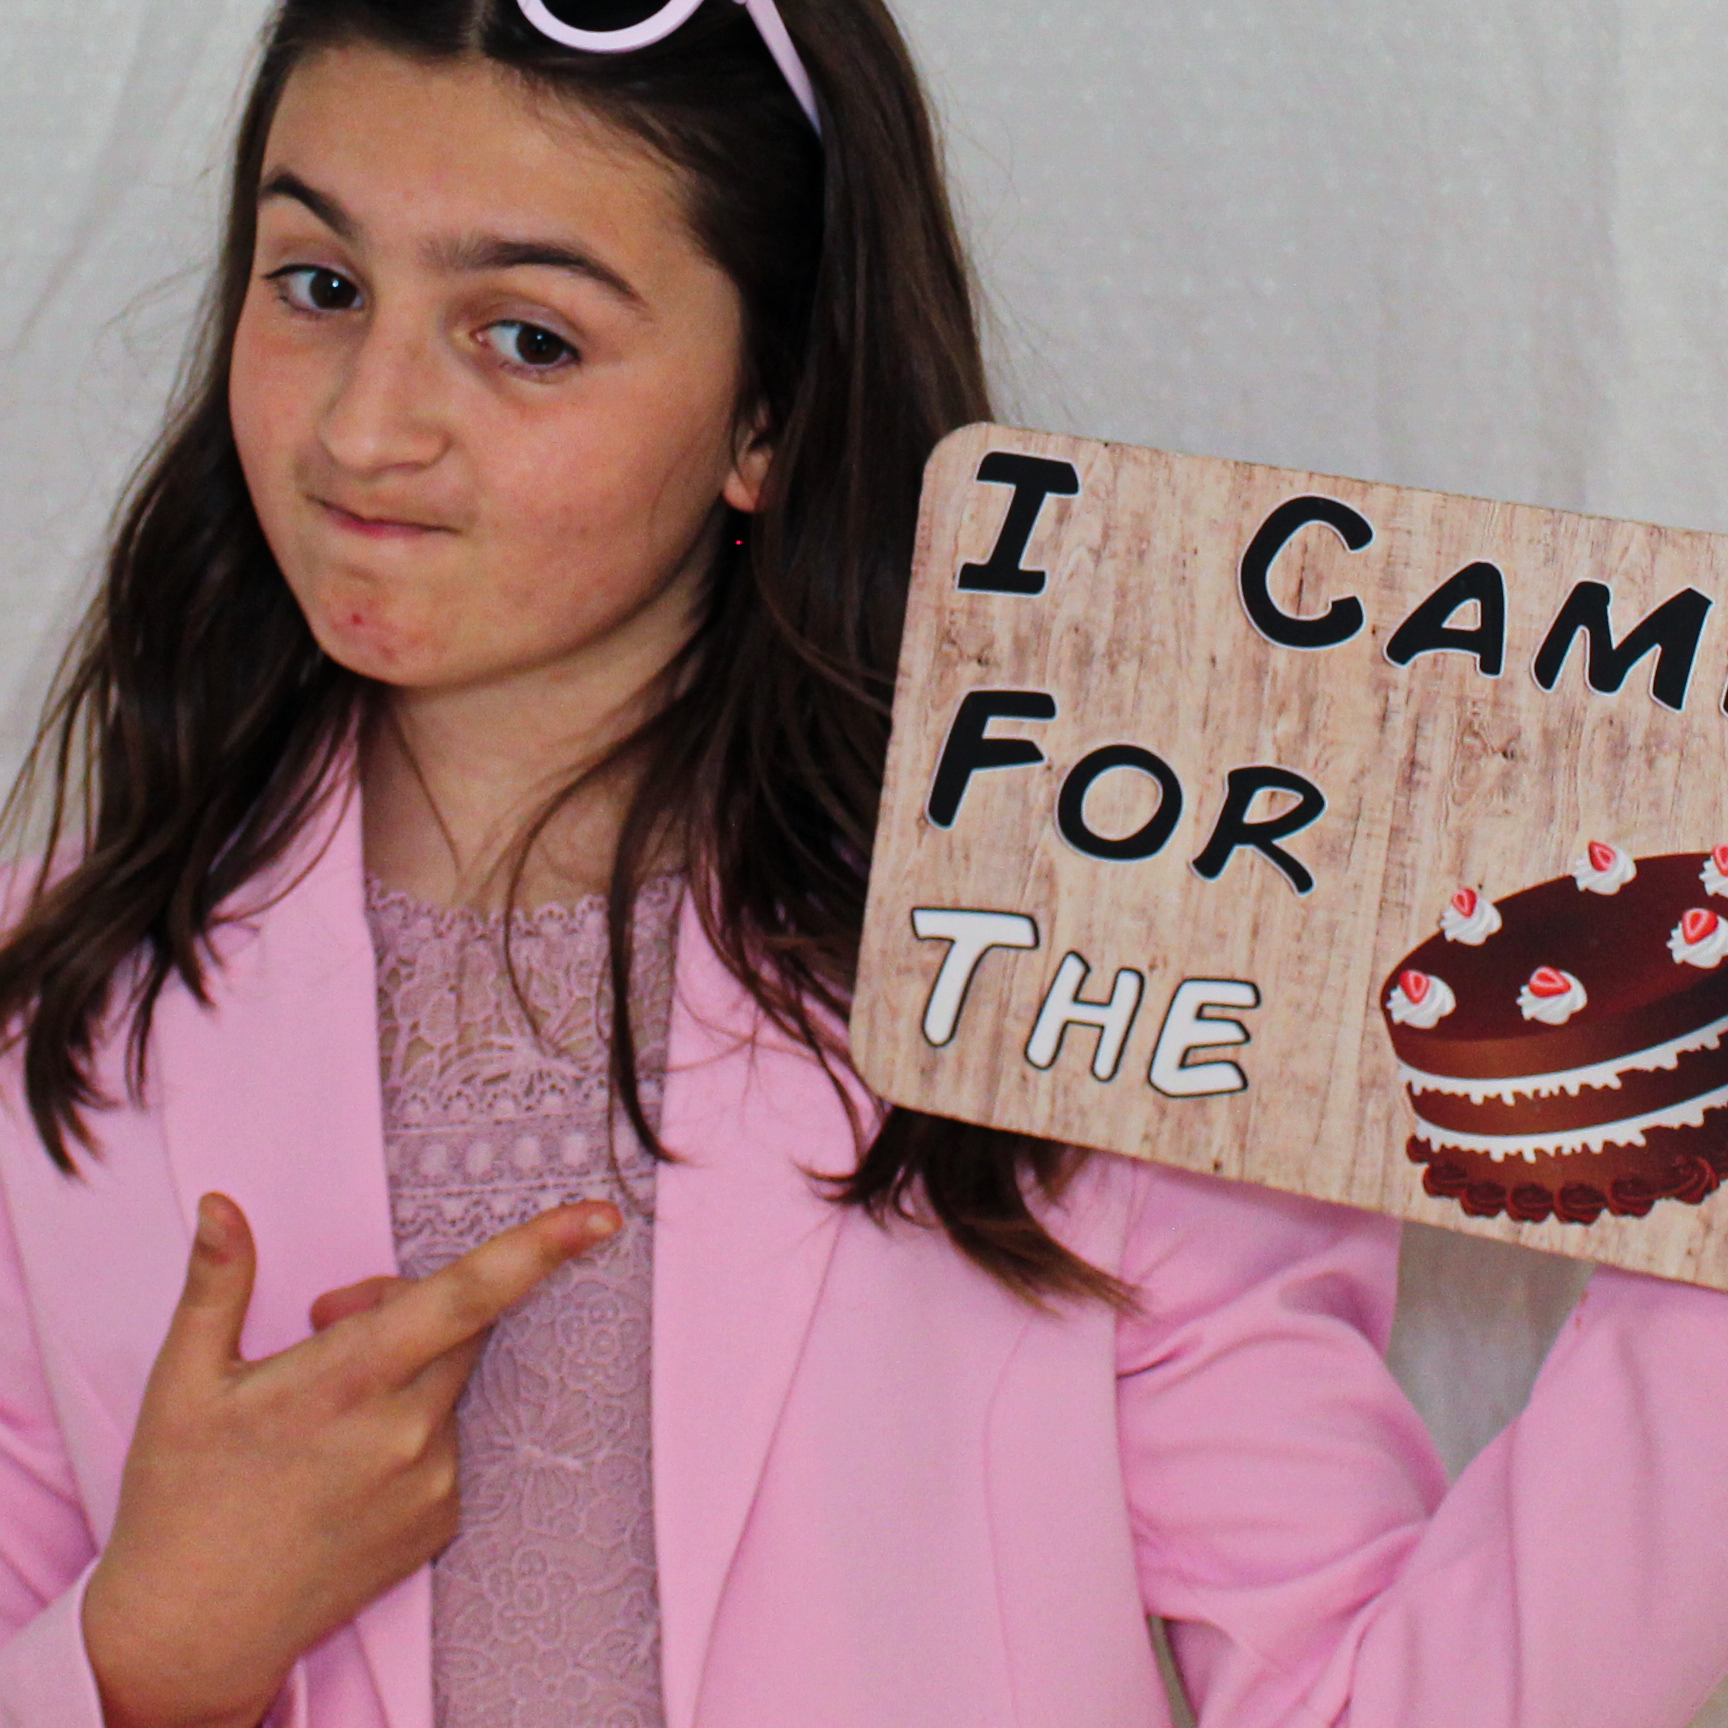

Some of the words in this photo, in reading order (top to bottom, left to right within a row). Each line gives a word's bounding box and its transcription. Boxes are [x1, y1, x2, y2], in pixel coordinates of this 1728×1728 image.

[956, 450, 1079, 595] I
[926, 689, 1327, 897] FOR
[910, 907, 1261, 1099] THE
